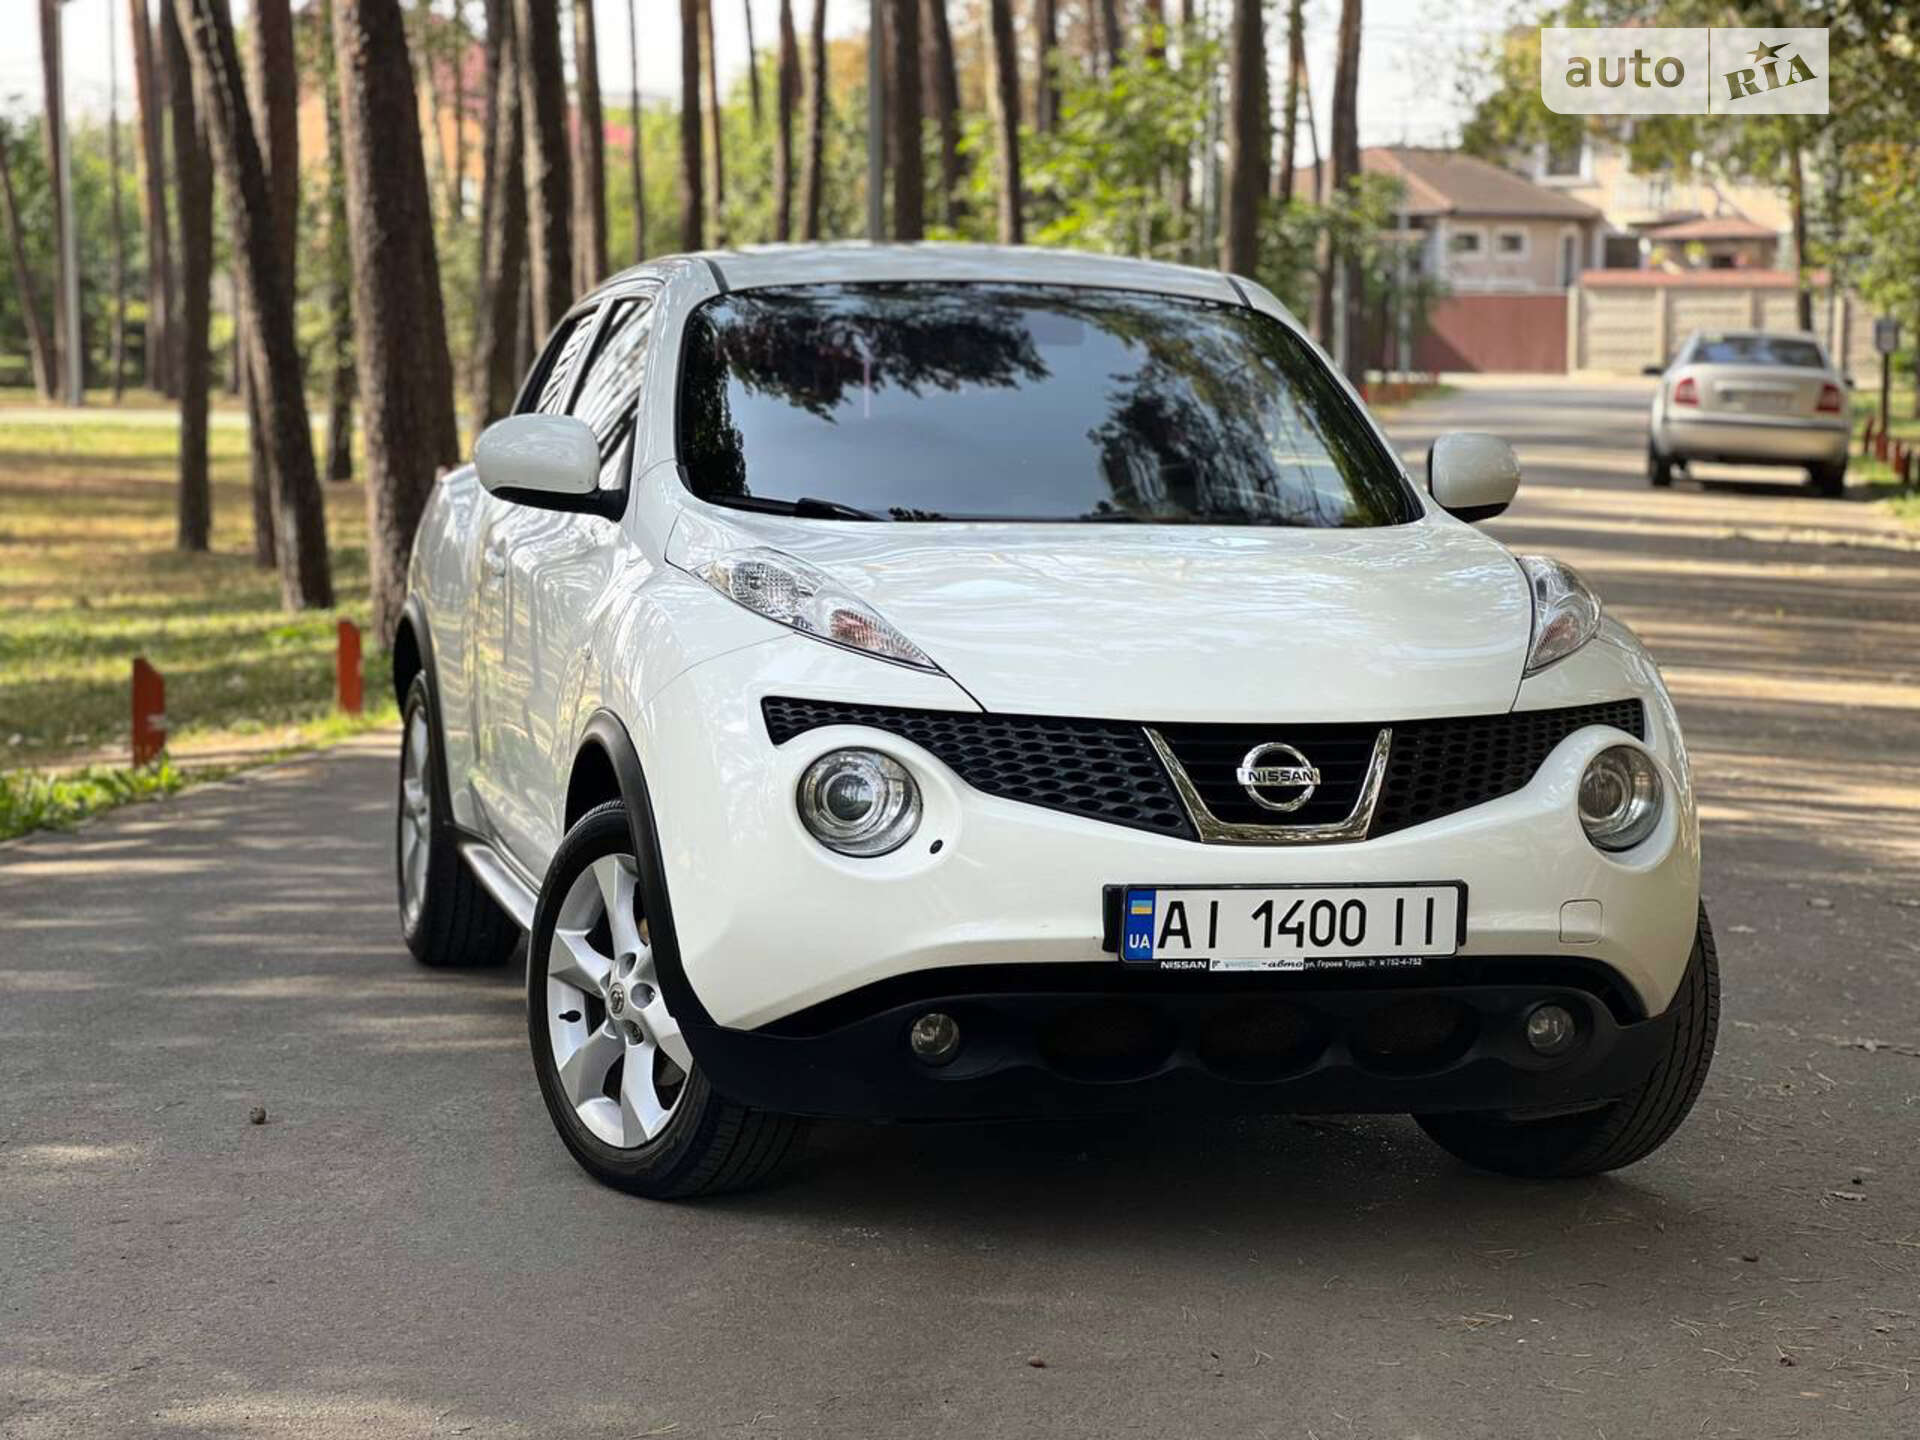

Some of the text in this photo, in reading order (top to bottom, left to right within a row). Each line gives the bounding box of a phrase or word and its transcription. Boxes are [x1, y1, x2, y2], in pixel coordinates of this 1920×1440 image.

[1248, 770, 1314, 782] NISSAN
[1157, 900, 1220, 949] AI
[1251, 897, 1367, 948] 1400
[1128, 933, 1151, 950] UA
[1160, 960, 1207, 970] NISSAN
